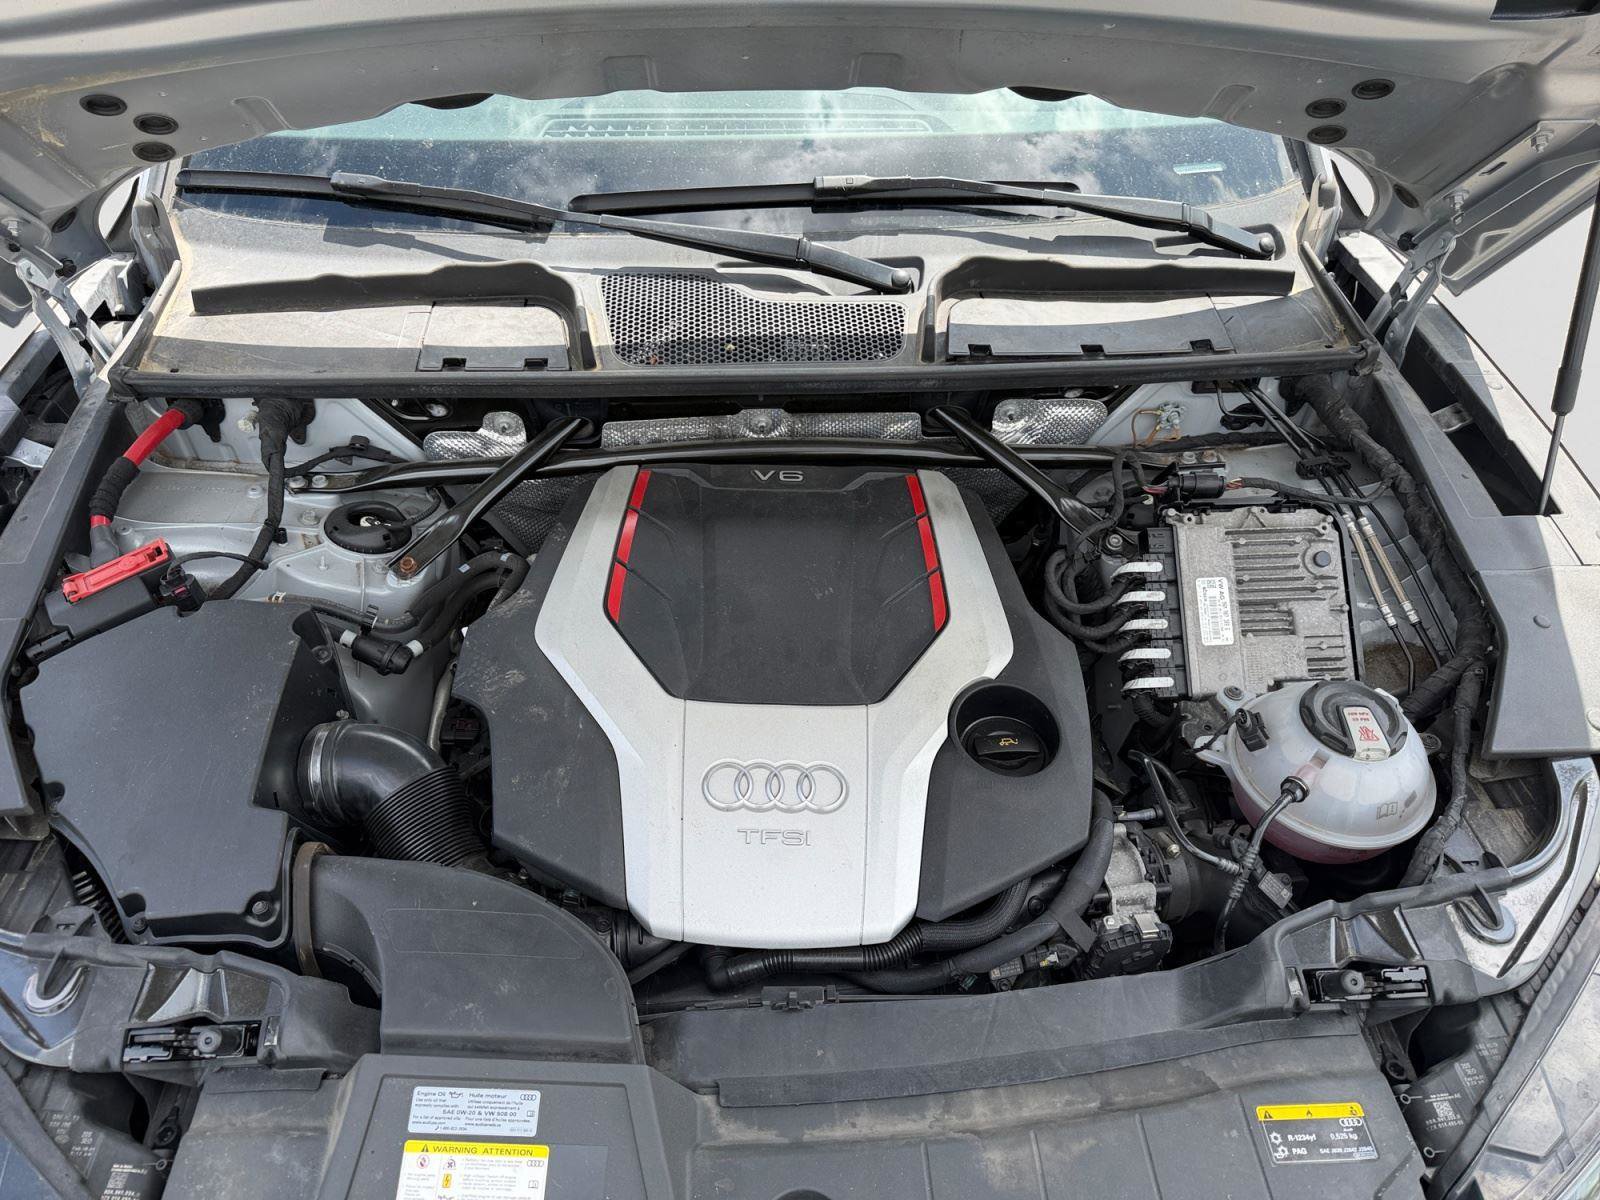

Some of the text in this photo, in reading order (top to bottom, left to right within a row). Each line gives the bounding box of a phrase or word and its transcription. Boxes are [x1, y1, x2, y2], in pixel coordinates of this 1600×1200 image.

[752, 469, 804, 482] V6
[737, 828, 811, 846] TFSI
[1287, 1133, 1317, 1142] R-1234yf
[1348, 1132, 1358, 1140] kg
[432, 1145, 534, 1157] WARNING ATTENTION
[1291, 1147, 1308, 1155] PAG
